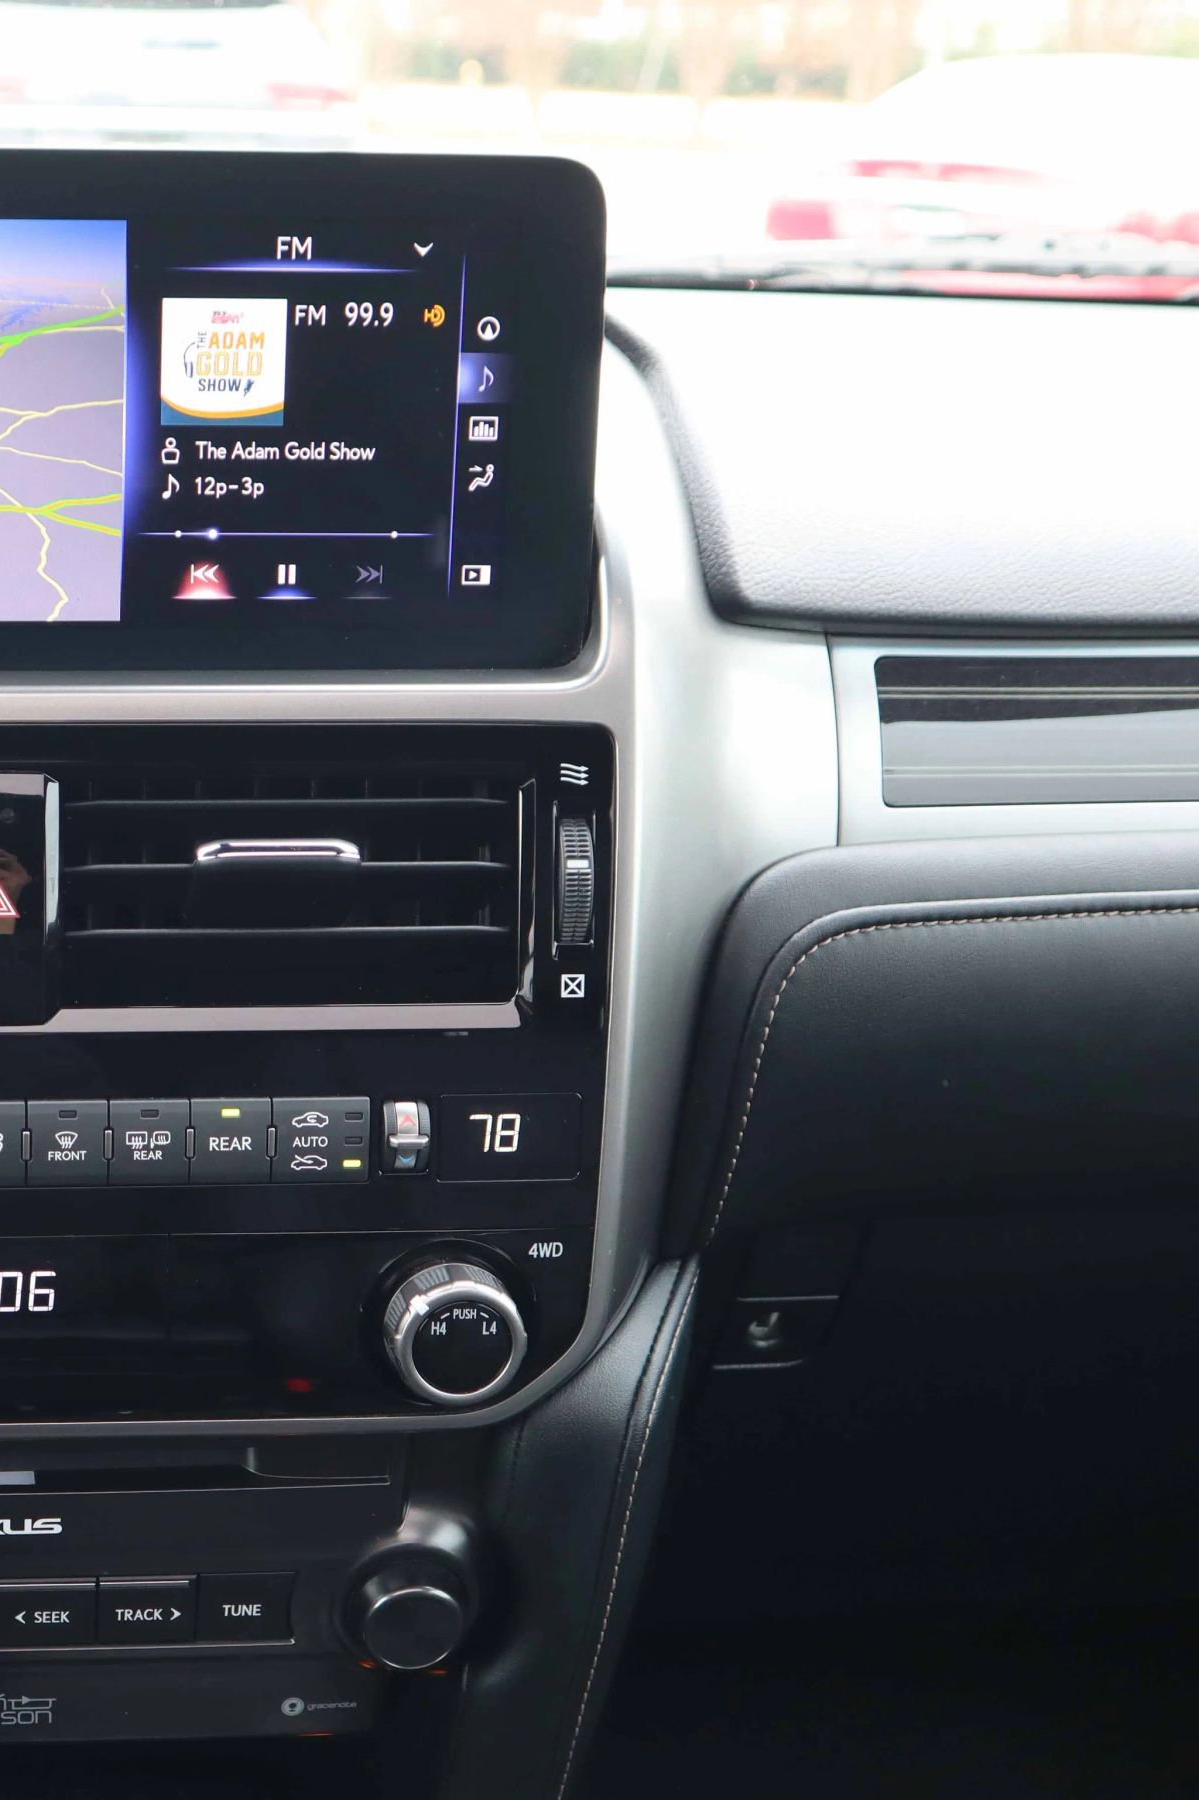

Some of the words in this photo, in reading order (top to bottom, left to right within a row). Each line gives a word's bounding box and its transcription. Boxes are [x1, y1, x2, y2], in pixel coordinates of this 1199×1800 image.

[276, 236, 312, 260] FM
[294, 304, 327, 326] FM
[344, 301, 394, 327] 99.9
[197, 331, 207, 349] THE
[209, 331, 265, 349] ADAM
[196, 351, 263, 377] GOLD
[198, 378, 242, 392] SHOW
[195, 440, 228, 460] The
[231, 441, 280, 460] Adam
[284, 441, 326, 460] Gold
[329, 441, 376, 461] Show
[469, 1113, 521, 1153] 78
[209, 1136, 252, 1152] REAR
[292, 1135, 329, 1148] AUTO
[47, 1150, 87, 1161] FRONT
[133, 1150, 163, 1161] REAR
[528, 1241, 564, 1259] 4WD
[452, 1308, 477, 1320] PUSH
[430, 1321, 447, 1336] H4
[482, 1320, 497, 1335] L4
[34, 1610, 70, 1624] SEEK
[115, 1608, 163, 1621] TRACK
[222, 1604, 262, 1617] TUNE
